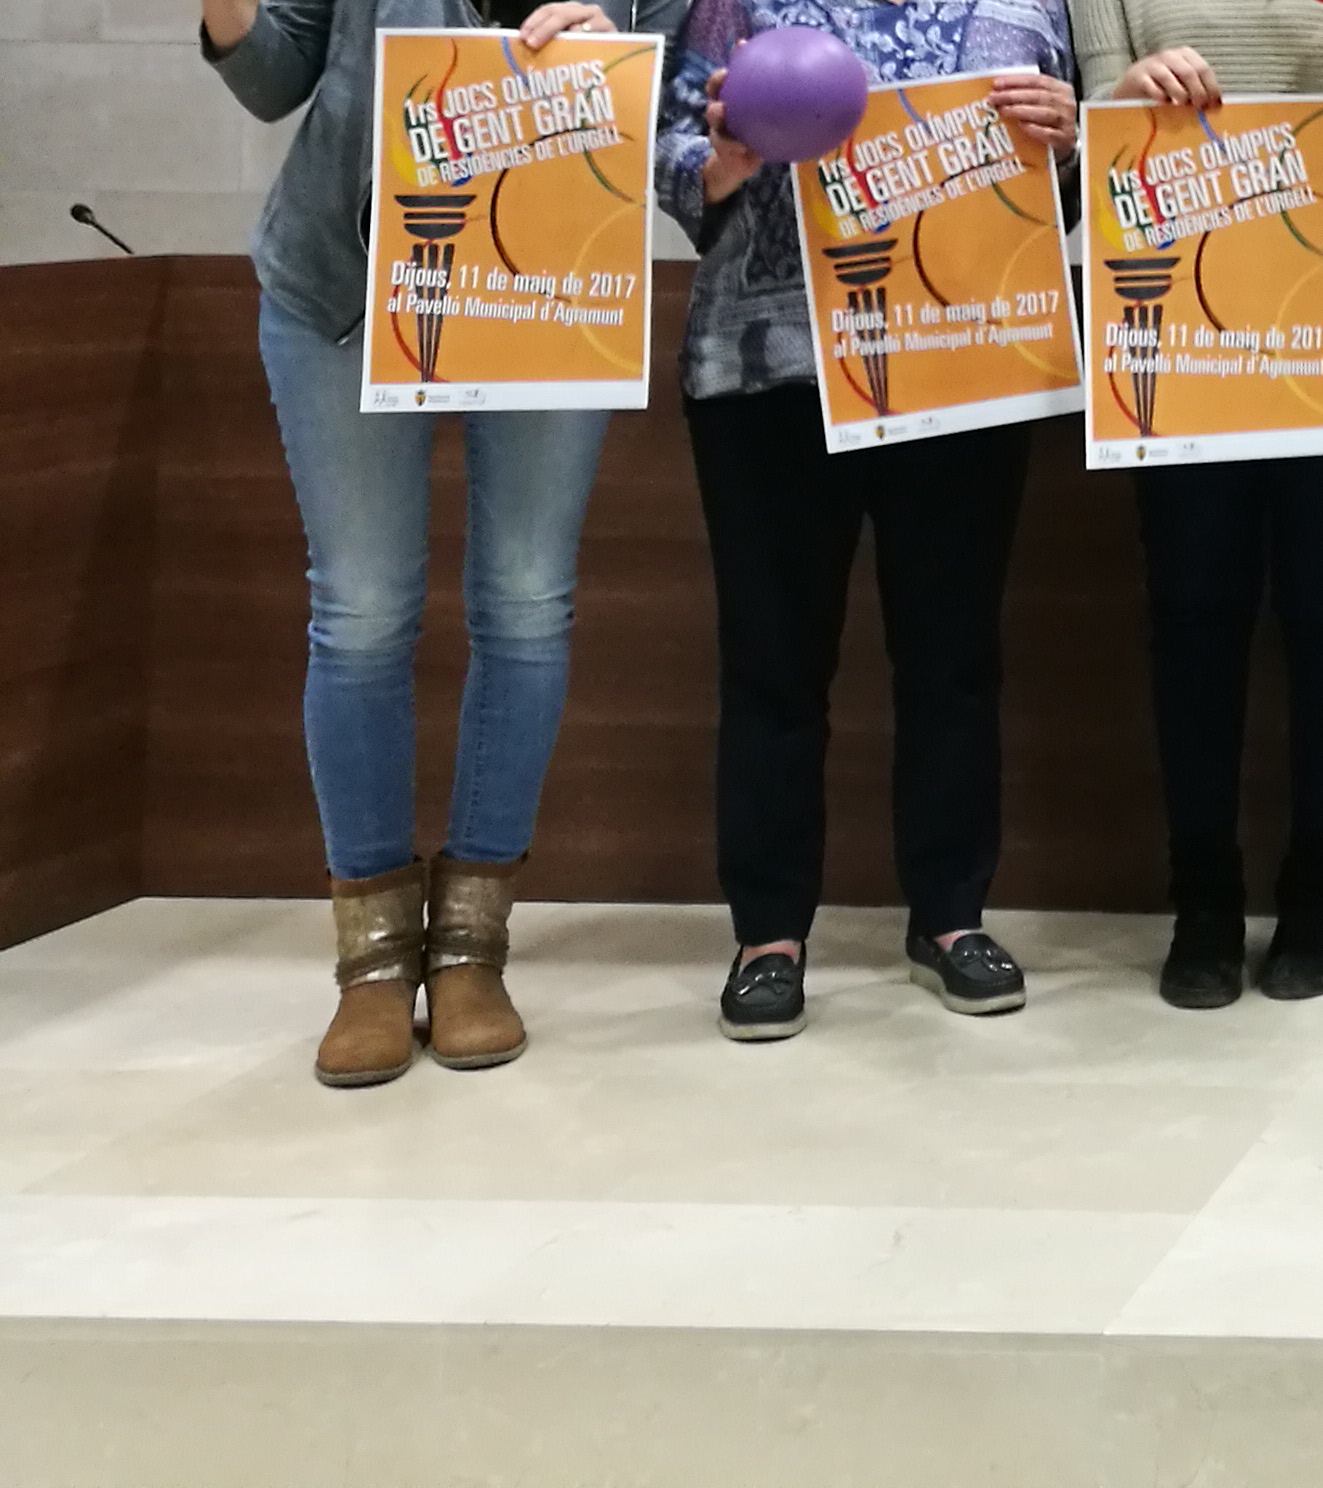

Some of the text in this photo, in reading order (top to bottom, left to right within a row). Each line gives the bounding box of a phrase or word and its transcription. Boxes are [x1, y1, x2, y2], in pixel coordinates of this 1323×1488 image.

[403, 99, 439, 126] 1rs
[443, 83, 497, 118] JOCS
[408, 87, 614, 163] DE GENT GRAN
[825, 122, 1014, 217] DE GENT GRAN
[854, 134, 903, 171] JOCS
[1108, 167, 1142, 193] 1rs
[1145, 150, 1196, 185] JOCS
[1114, 150, 1307, 229] DE GENT GRAN
[460, 265, 479, 289] 11
[487, 268, 507, 291] de
[513, 270, 555, 299] maig
[562, 272, 583, 295] de
[588, 273, 635, 298] 2017
[1017, 291, 1057, 316] 2017
[1168, 324, 1187, 346] 11
